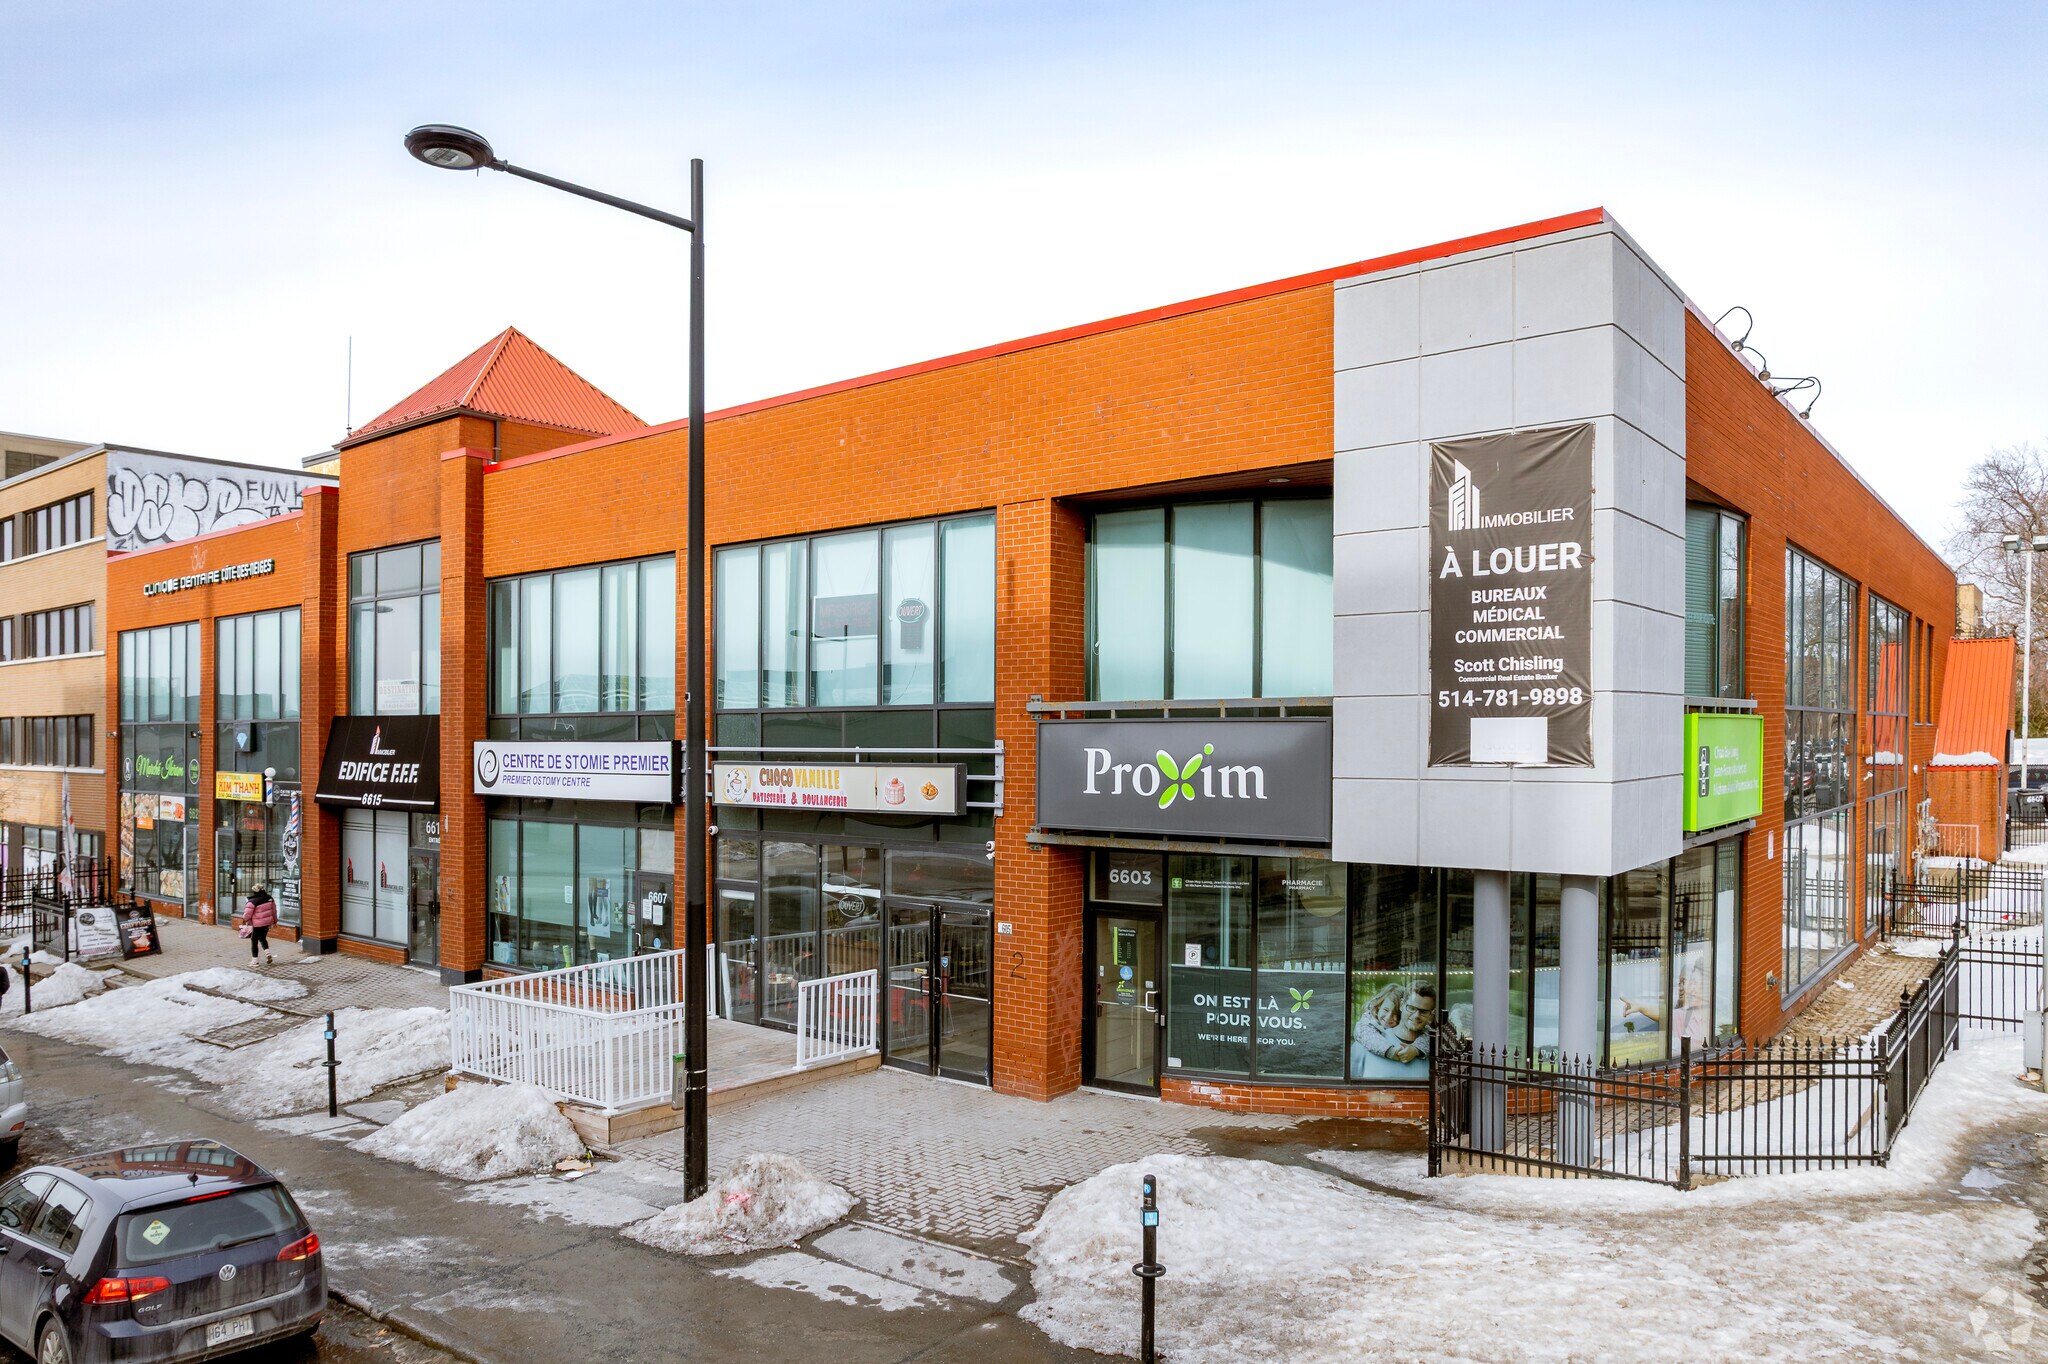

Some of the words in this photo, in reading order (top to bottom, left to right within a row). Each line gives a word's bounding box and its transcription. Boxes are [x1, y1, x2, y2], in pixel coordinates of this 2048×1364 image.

[1480, 507, 1575, 529] IMMOBILIER
[1439, 546, 1464, 579] À
[1472, 542, 1583, 577] LOUER
[180, 569, 221, 588] DENTAIRE
[1471, 586, 1547, 604] BUREAUX
[898, 605, 923, 617] OUVERT
[1473, 605, 1545, 623] MÉDICAL
[1455, 626, 1565, 644] COMMERCIAL
[1454, 656, 1495, 672] Scott
[1498, 656, 1564, 673] Chisling
[1458, 675, 1497, 683] Commercial
[1497, 674, 1513, 682] Real
[1513, 674, 1535, 682] Estate
[1438, 687, 1583, 708] 514-781-9898
[502, 753, 545, 769] CENTRE
[547, 754, 562, 769] DE
[565, 754, 610, 770] STOMIE
[614, 755, 670, 771] PREMIER
[338, 761, 390, 782] EDIFICE
[390, 763, 420, 784] F.F.F.
[502, 774, 531, 785] PREMIER
[532, 776, 561, 786] OSTOMY
[562, 777, 591, 787] CENTRE
[1082, 743, 1268, 810] Proxim
[218, 782, 232, 793] KIM
[234, 781, 260, 794] THANH
[361, 793, 382, 806] 6615
[752, 792, 786, 804] PATISSERIE
[791, 792, 798, 805] &
[802, 793, 848, 807] BOULANGERIE
[425, 821, 440, 835] 661
[1109, 869, 1152, 885] 6603
[648, 891, 668, 904] 6607
[841, 901, 863, 911] OUVERT
[1193, 994, 1218, 1007] ON
[1222, 995, 1250, 1009] EST
[1258, 995, 1279, 1011] LÀ
[1206, 1012, 1250, 1027] POUR
[1257, 1016, 1307, 1029] VOUS.
[1197, 1033, 1225, 1042] WE'RE
[1227, 1035, 1248, 1044] HERE
[1257, 1037, 1274, 1045] FOR
[1276, 1038, 1296, 1046] YOU.
[137, 1304, 163, 1313] GOLF
[208, 1326, 227, 1341] H64
[232, 1319, 251, 1335] PHT
